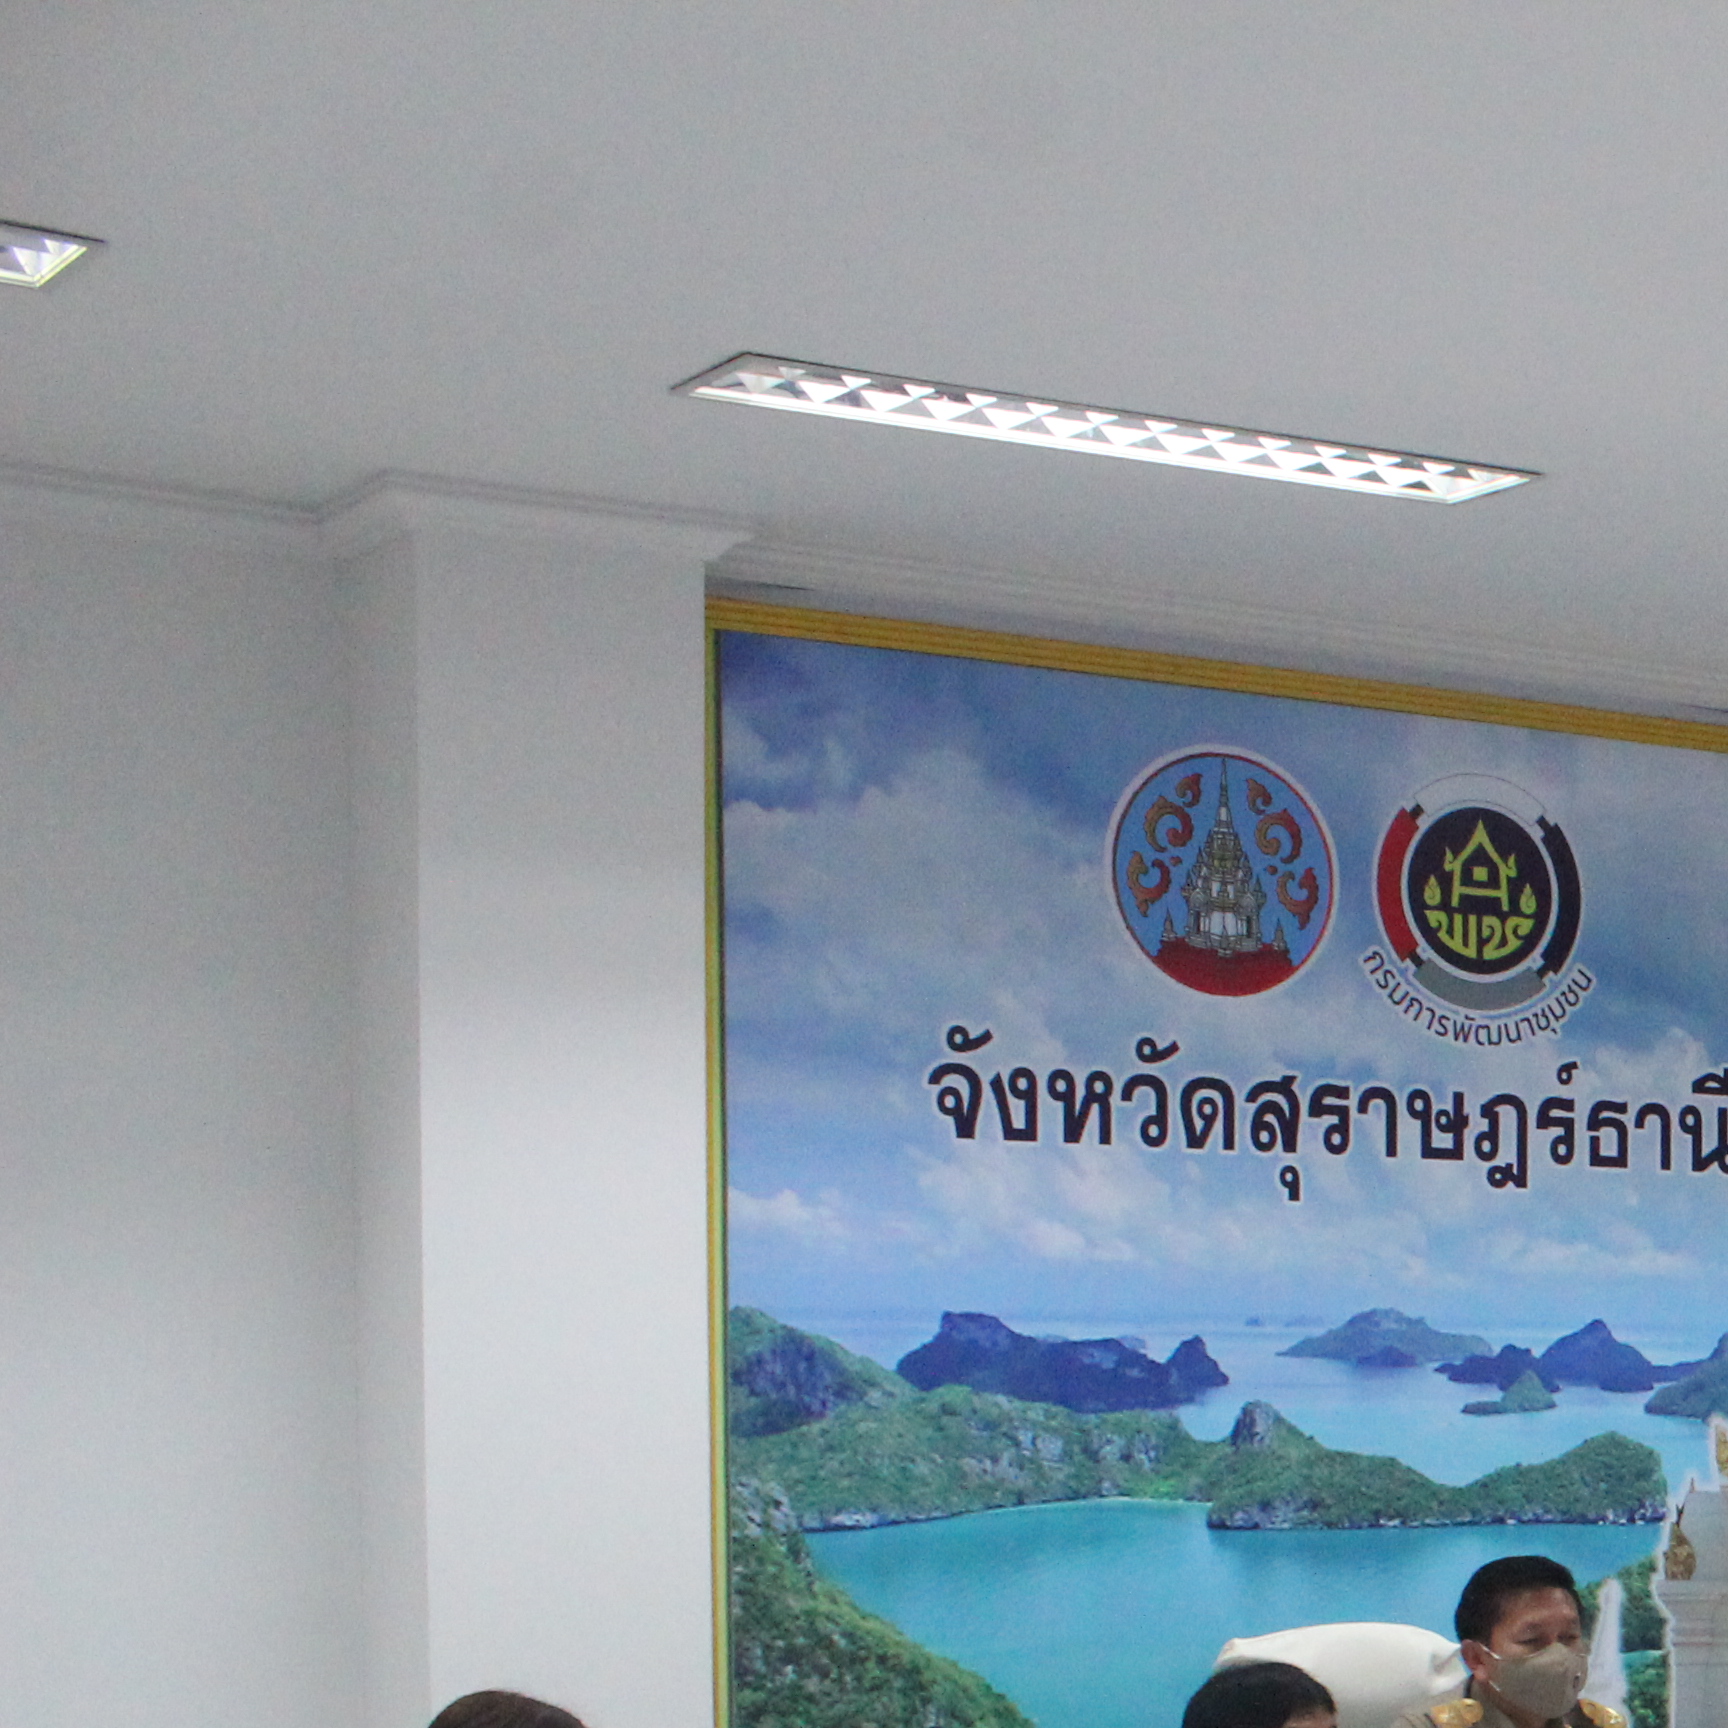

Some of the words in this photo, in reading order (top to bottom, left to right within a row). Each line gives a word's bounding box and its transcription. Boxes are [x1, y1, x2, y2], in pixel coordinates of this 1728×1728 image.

[1363, 950, 1594, 1047] กรมการพัฒนาชุมชน
